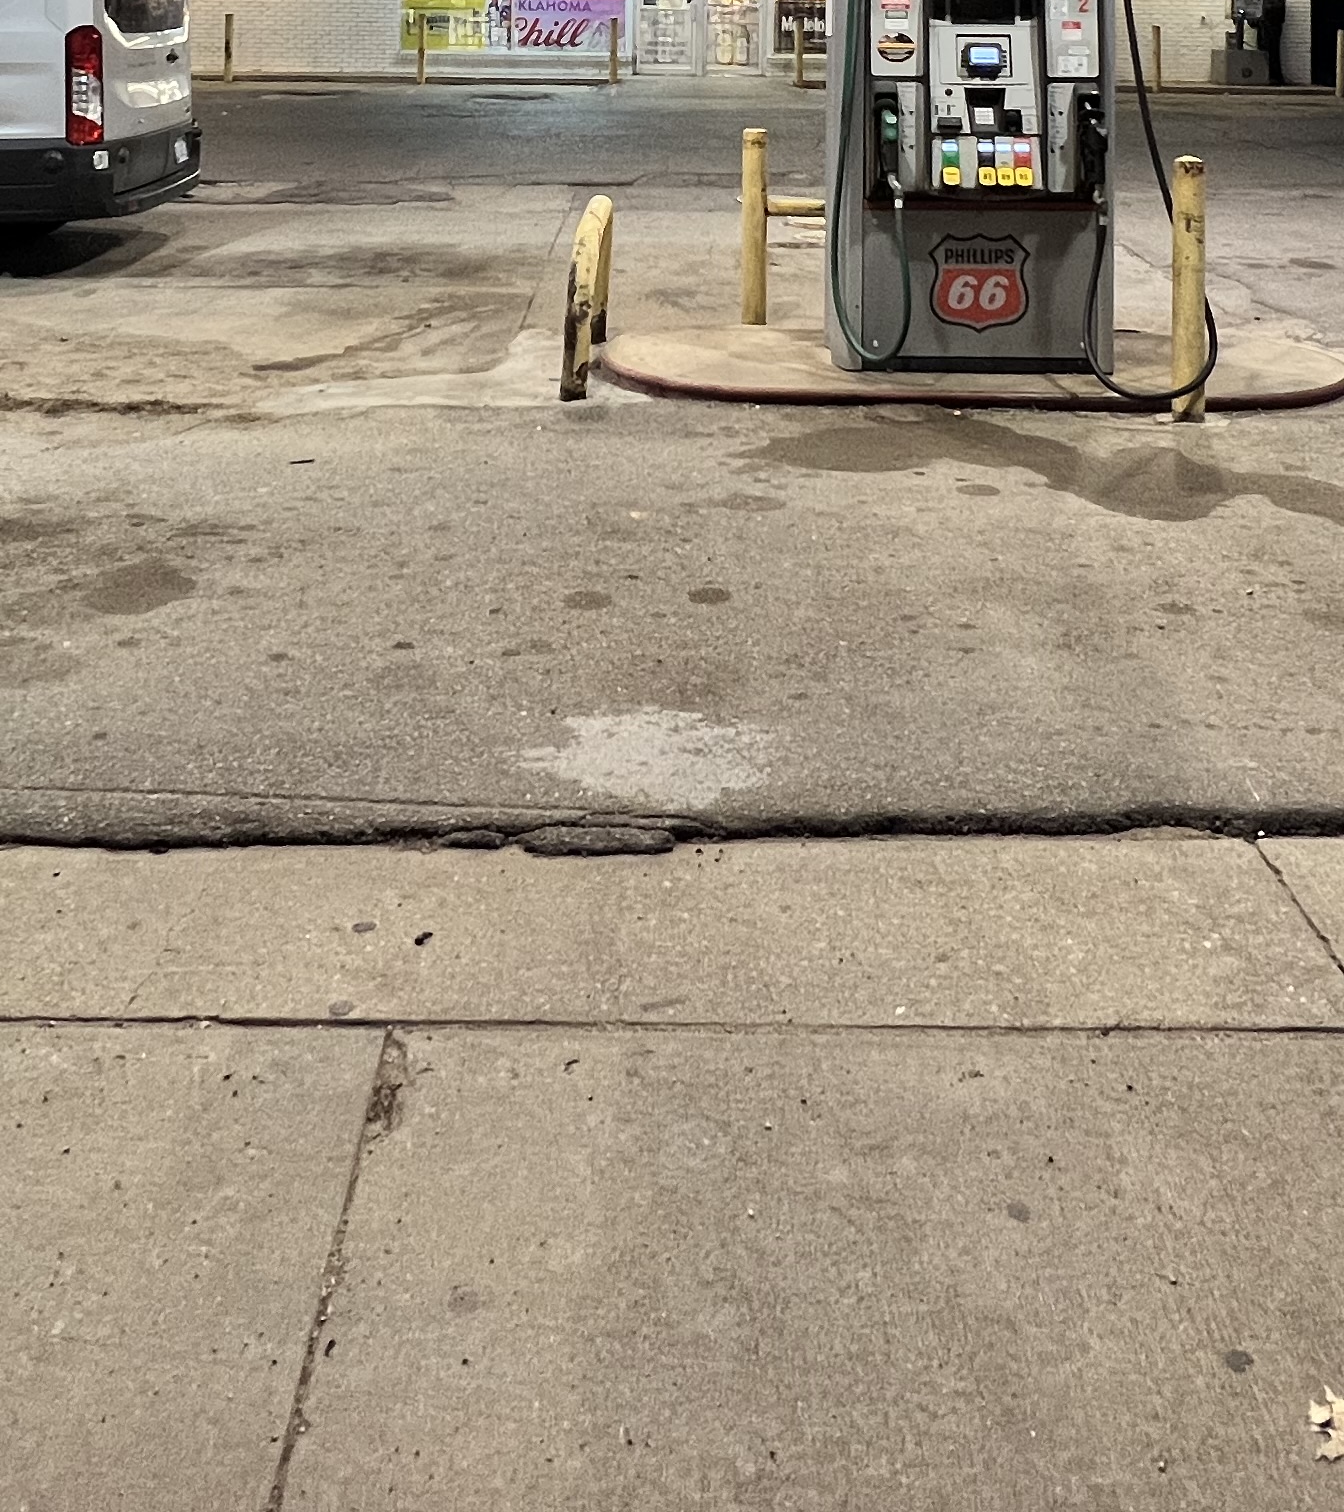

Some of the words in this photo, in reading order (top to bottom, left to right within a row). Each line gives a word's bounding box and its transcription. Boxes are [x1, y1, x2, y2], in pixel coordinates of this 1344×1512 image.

[781, 15, 825, 32] Melo
[944, 248, 1015, 265] PHILLIPS
[947, 275, 1009, 310] 66
